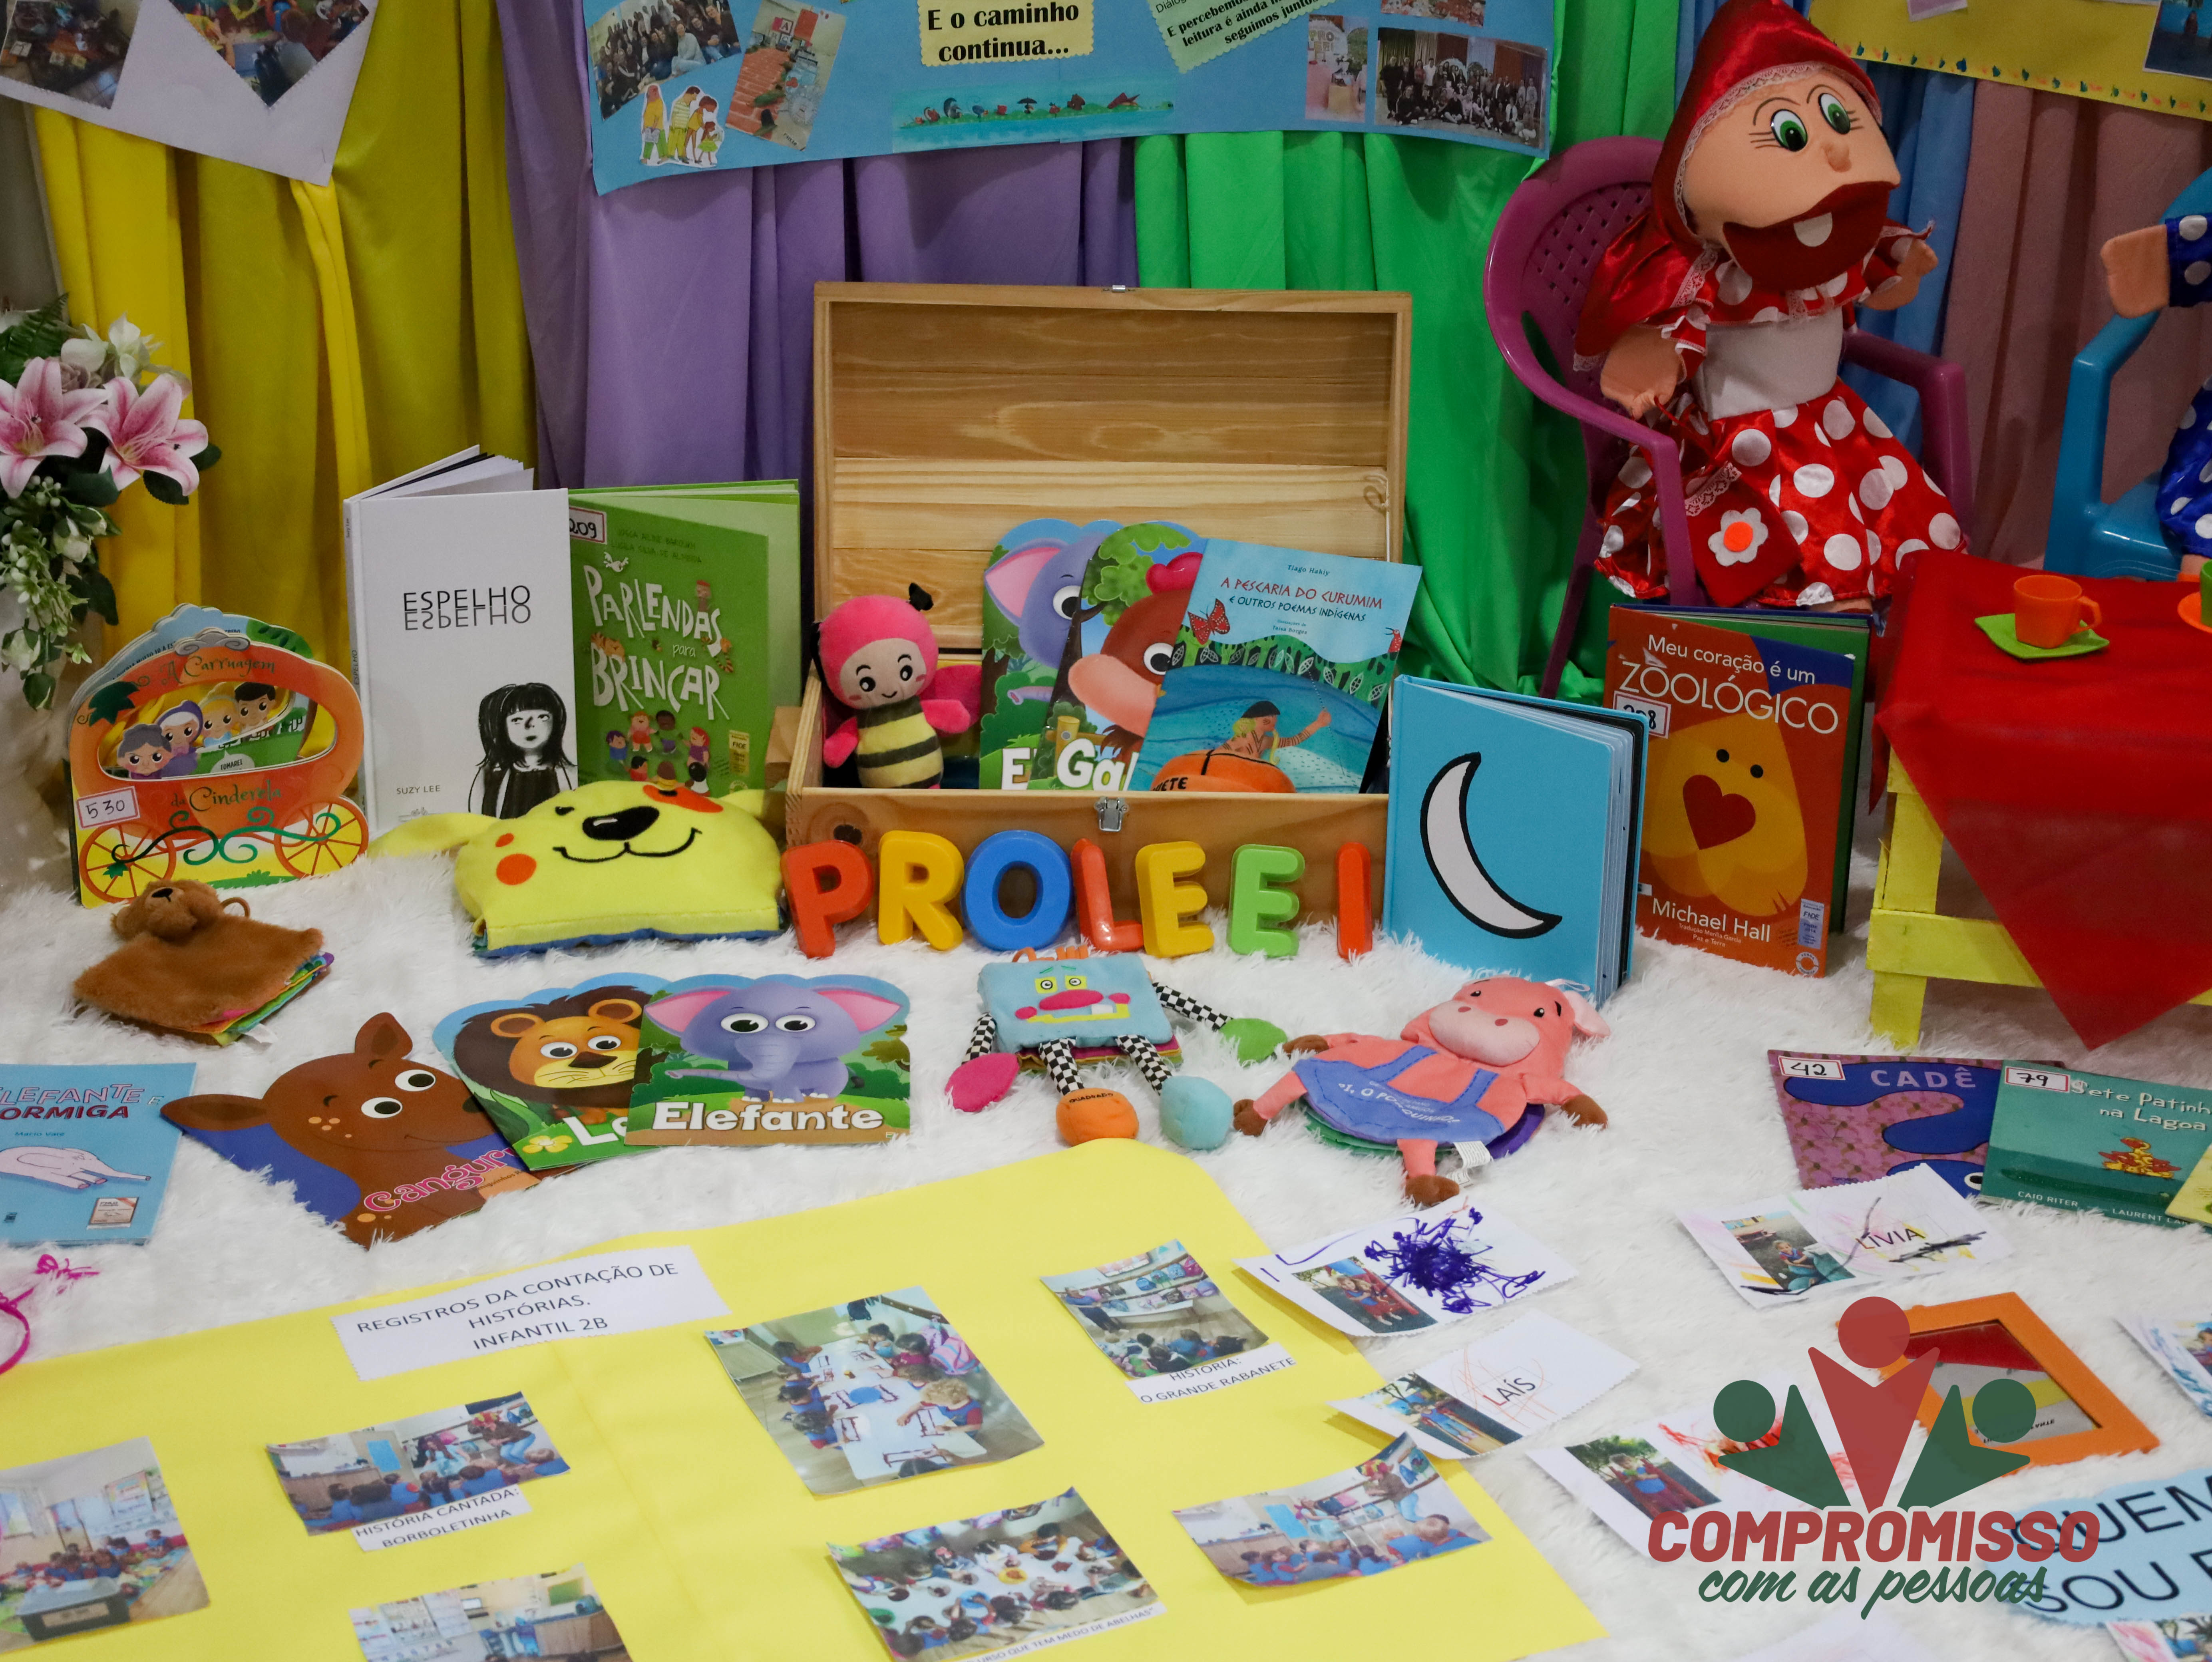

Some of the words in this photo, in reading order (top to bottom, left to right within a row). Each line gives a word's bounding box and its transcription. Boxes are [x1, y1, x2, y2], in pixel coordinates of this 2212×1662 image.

[928, 10, 942, 30] E
[951, 13, 965, 28] o
[974, 2, 1079, 26] caminho
[1166, 26, 1177, 37] E
[1178, 0, 1249, 34] percebemo
[1182, 24, 1223, 47] leitura
[1225, 17, 1233, 26] é
[1236, 1, 1268, 22] ainda
[1225, 12, 1279, 44] seguimos
[939, 38, 1068, 62] continua...
[1287, 565, 1306, 573] Tiago
[1309, 567, 1330, 577] Hakiy
[403, 585, 531, 612] ESPELHO
[1221, 577, 1229, 588] A
[1234, 579, 1290, 597] PESCARIA
[1295, 586, 1317, 600] DO
[1321, 590, 1383, 609] CURUMIM
[1237, 597, 1276, 609] OUTROS
[1278, 602, 1317, 615] POEMAS
[584, 565, 723, 657] PARLENDAS
[673, 642, 696, 658] para
[1648, 634, 1687, 658] Meu
[1693, 647, 1764, 674] coração
[1770, 661, 1781, 675] é
[1787, 669, 1815, 685] um
[160, 660, 183, 686] A
[184, 656, 275, 677] Carruagem
[591, 640, 730, 720] BRINCAR
[1619, 661, 1839, 734] ZOOLÓGICO
[171, 794, 185, 807] da
[189, 780, 282, 812] Cinderela
[396, 785, 421, 795] SUZY
[423, 784, 441, 793] LEE
[86, 799, 125, 819] 530
[1653, 898, 1726, 932] Michael
[1734, 918, 1770, 942] Hall
[1803, 911, 1820, 920] FNDE
[1679, 922, 1703, 934] Tradução
[1724, 934, 1741, 943] Garcia
[1711, 938, 1726, 947] Terra
[1790, 1062, 1827, 1076] 42
[1870, 1067, 1976, 1088] CADÊ
[2017, 1073, 2048, 1087] 79
[0, 1083, 145, 1105] LEFANTE
[147, 1096, 164, 1105] E
[2071, 1080, 2130, 1101] Sete
[652, 1101, 884, 1131] Elefante
[2100, 1108, 2124, 1118] na
[2134, 1108, 2206, 1131] Lagoa
[364, 1147, 514, 1212] Cangur
[2018, 1191, 2043, 1201] CAIO
[2047, 1195, 2078, 1207] RITER
[2112, 1207, 2162, 1222] LAURENT
[357, 1298, 480, 1332] REGISTROS
[484, 1289, 518, 1305] DA
[523, 1265, 643, 1295] CONTAÇÃO
[649, 1262, 678, 1276] DE
[468, 1293, 591, 1329] HISTÓRIAS.
[473, 1320, 575, 1350] INFANTIL
[580, 1317, 608, 1332] 2B
[1140, 1394, 1153, 1403] O
[1156, 1381, 1218, 1401] GRANDE
[1220, 1357, 1296, 1386] RABANETE
[1482, 1377, 1536, 1407] LAÍS
[356, 1511, 433, 1537] HISTÓRIA
[436, 1486, 519, 1517] CANTADA:
[382, 1509, 512, 1547] BORBOLETINHA
[2009, 1561, 2180, 1612] SOU
[1056, 1628, 1090, 1642] MEDO
